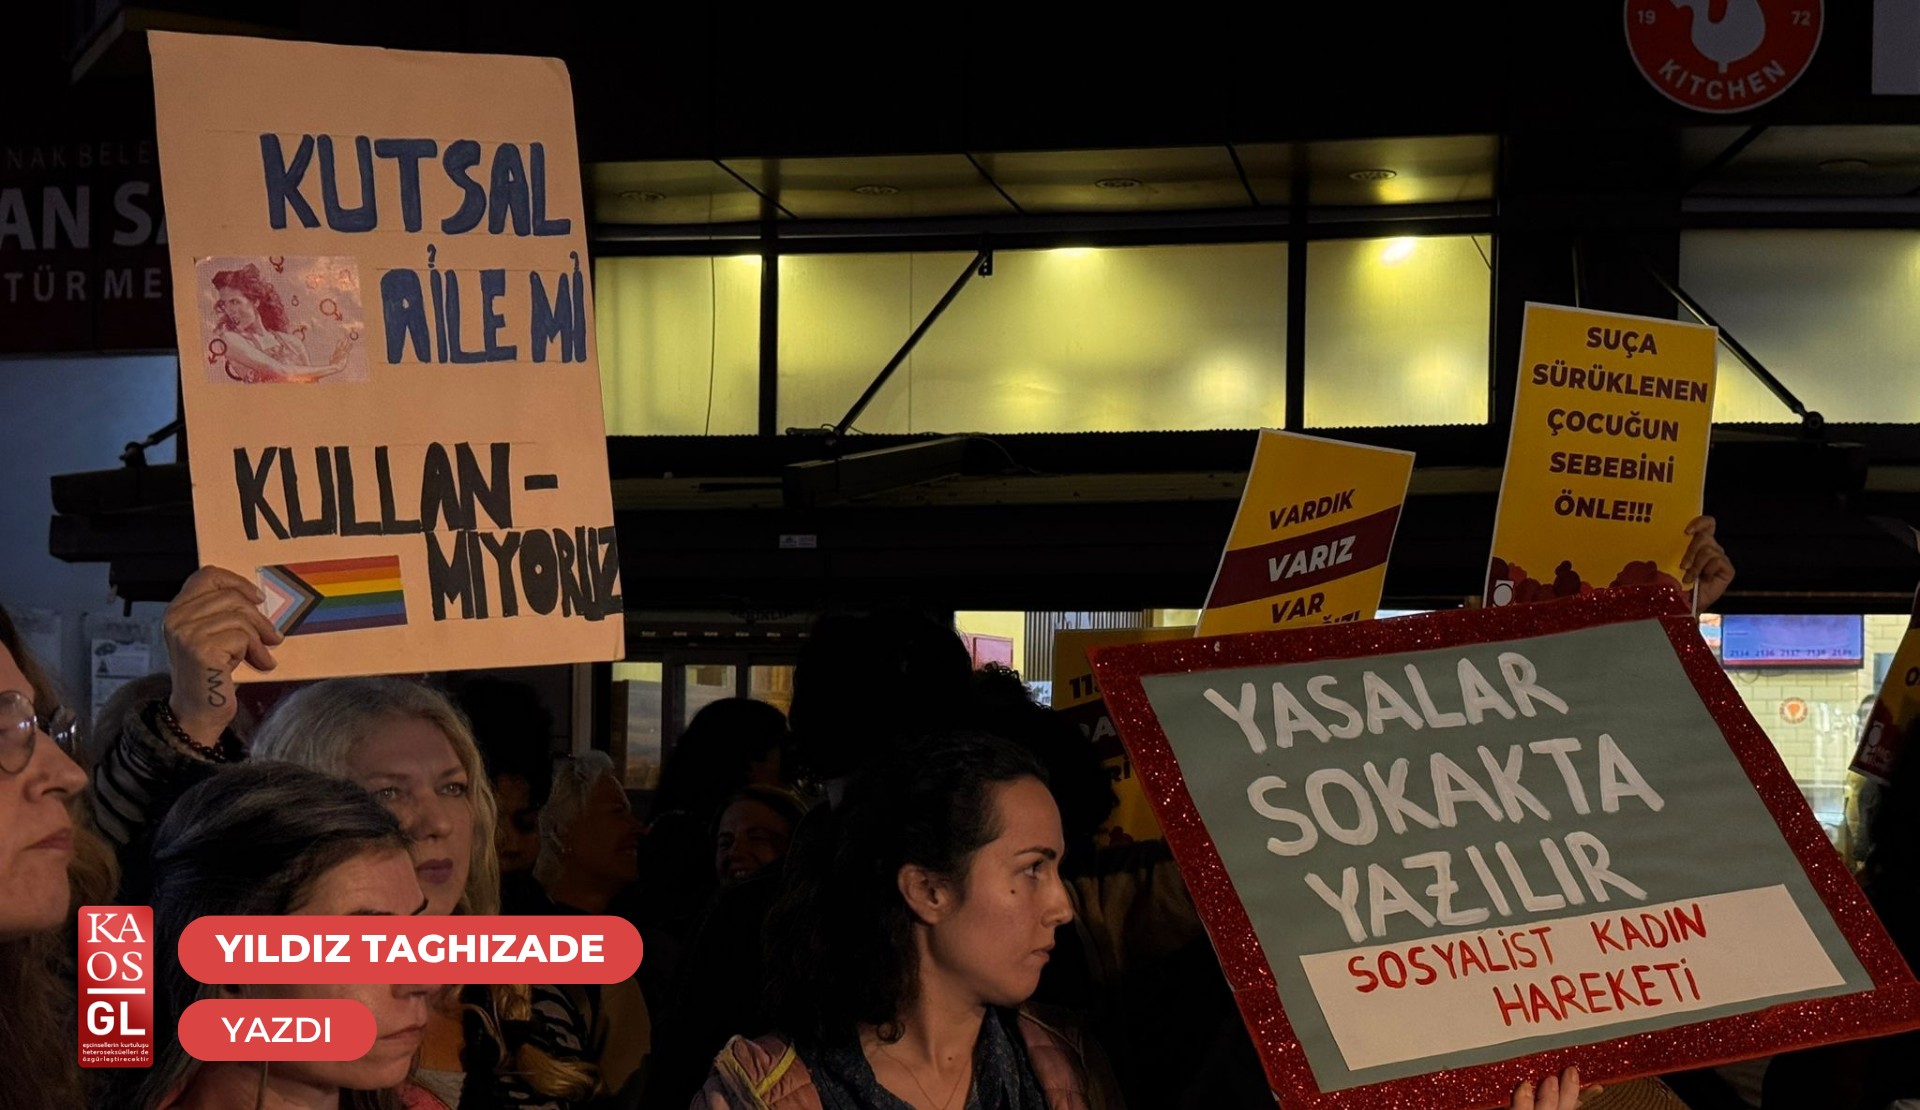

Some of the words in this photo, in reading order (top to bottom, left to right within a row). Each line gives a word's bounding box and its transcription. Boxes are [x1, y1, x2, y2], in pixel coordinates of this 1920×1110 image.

[1637, 11, 1656, 25] 19
[1791, 10, 1811, 26] 72
[1658, 58, 1786, 100] KITCHEN
[260, 133, 571, 236] KUTSAL
[3, 264, 87, 303] TÜR
[103, 267, 163, 300] ME
[1587, 327, 1657, 358] SUÇA
[1532, 359, 1708, 402] SÜRÜKLENEN
[1547, 408, 1679, 442] ÇOCUĞUN
[1550, 453, 1674, 483] SEBEBİNİ
[1269, 488, 1356, 530] VARDIK
[1554, 489, 1653, 523] ÖNLE!!!
[1268, 535, 1357, 582] VARIZ
[1272, 592, 1325, 624] VAR
[1204, 650, 1569, 755] YASALAR
[1246, 733, 1665, 858] SOKAKTA
[1305, 830, 1648, 943] YAZILIR
[1348, 930, 1554, 993] SOSYALİST
[1591, 903, 1707, 955] KADIN
[1493, 958, 1701, 1027] HAREKETİ
